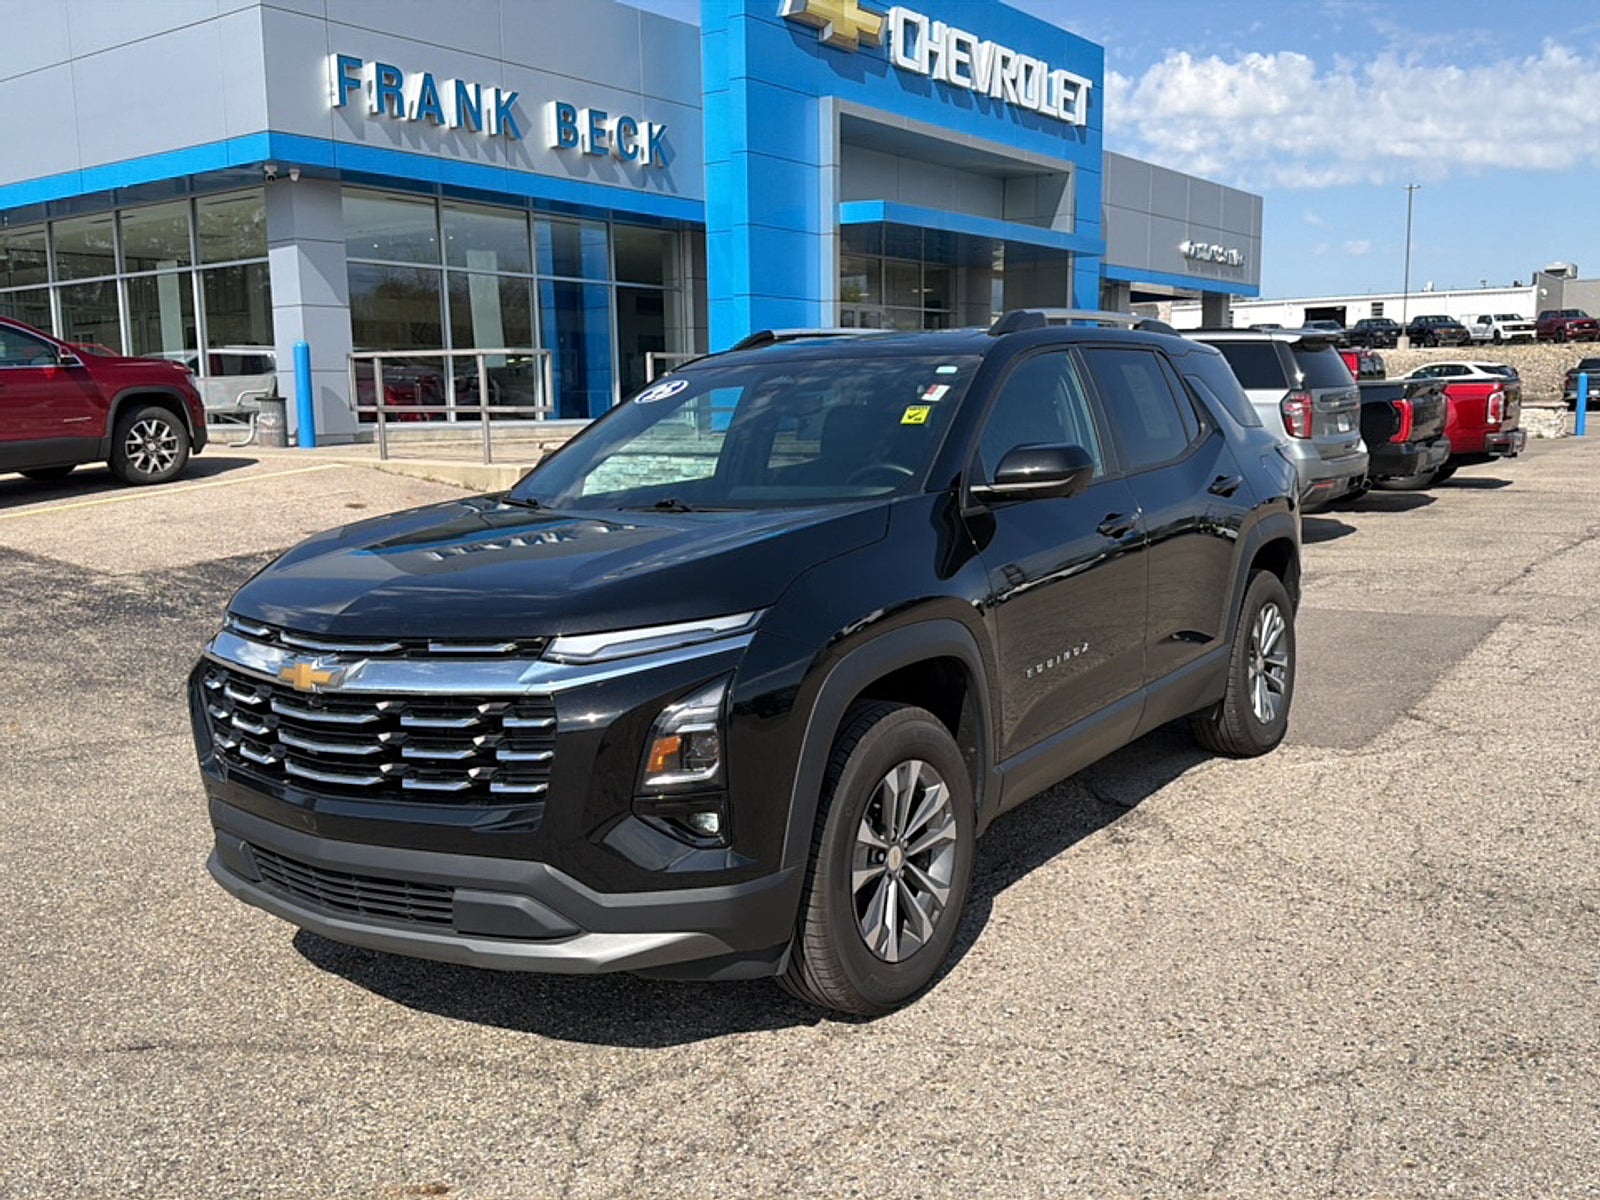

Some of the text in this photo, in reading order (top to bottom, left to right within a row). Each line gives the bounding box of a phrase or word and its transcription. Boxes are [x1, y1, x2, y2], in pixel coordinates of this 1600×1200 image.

[329, 53, 668, 167] FRANK BECK
[887, 6, 1093, 126] CHEVROLET
